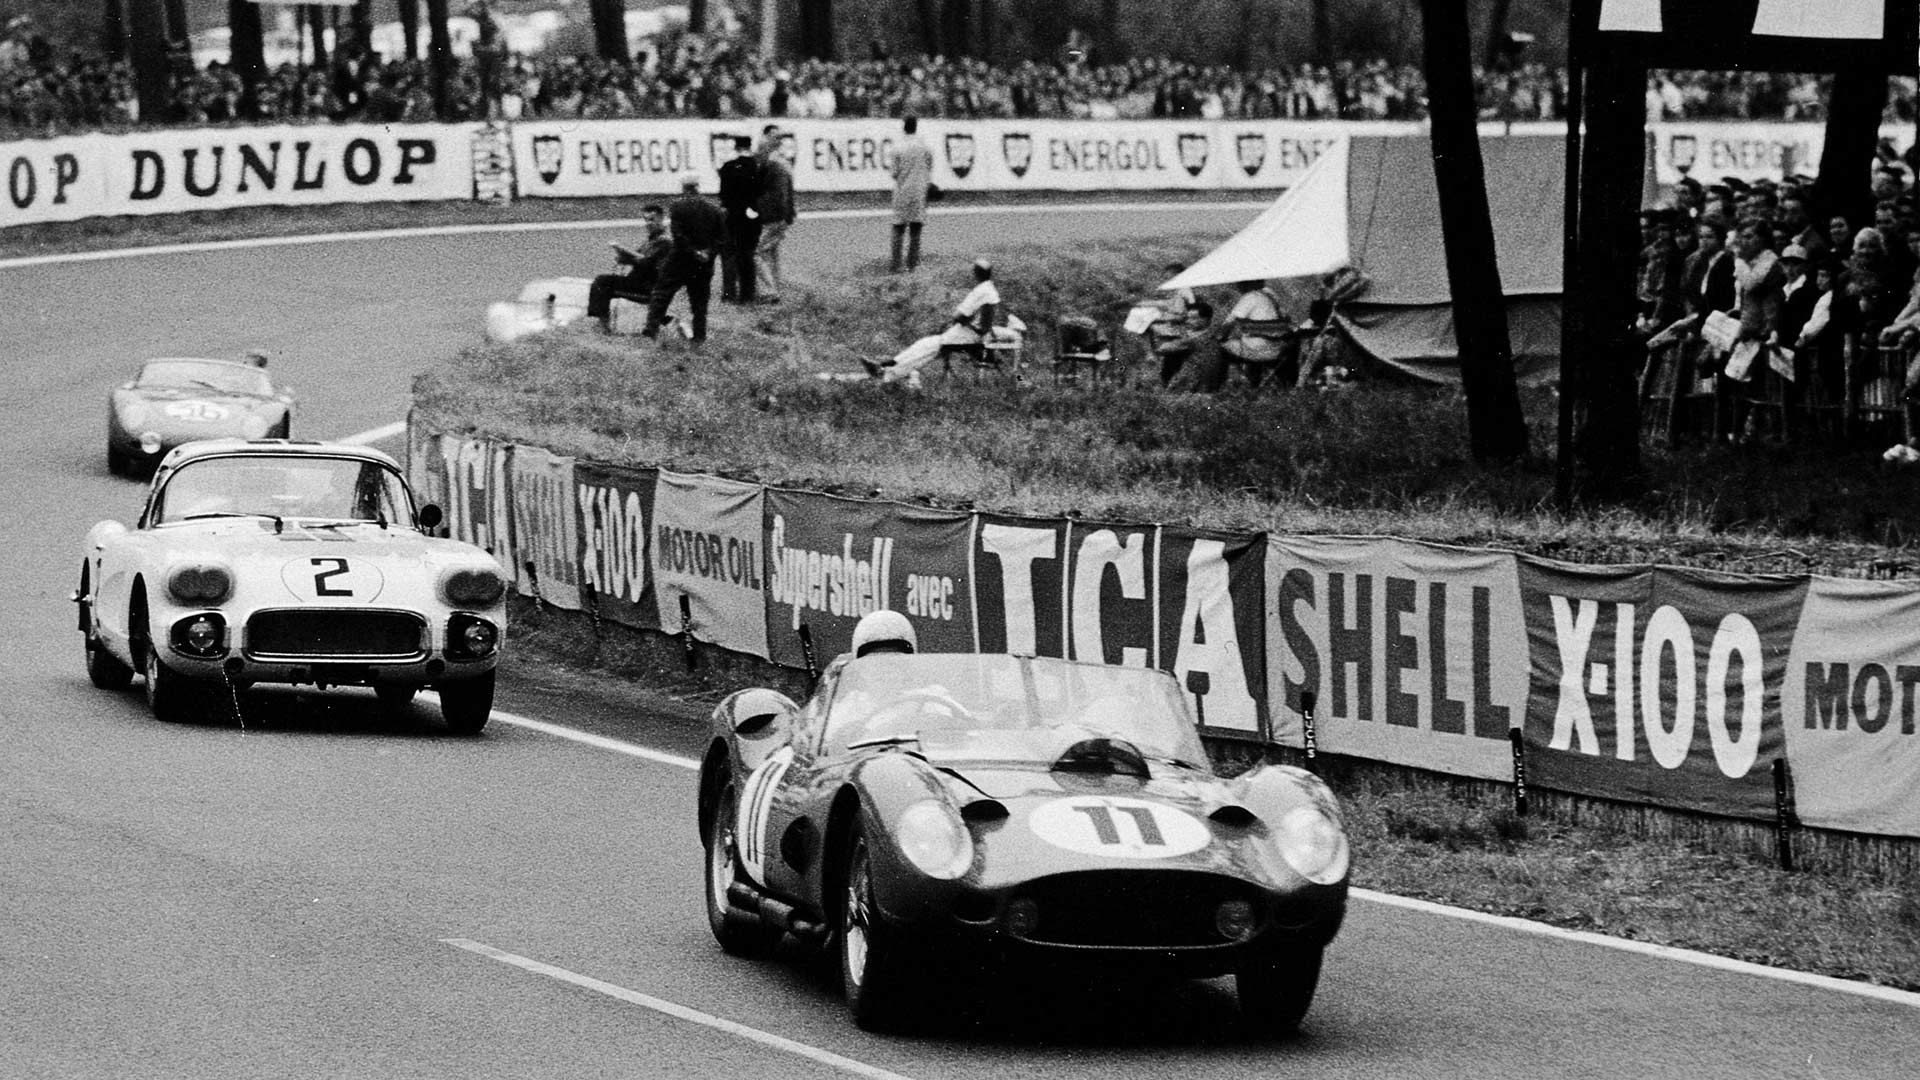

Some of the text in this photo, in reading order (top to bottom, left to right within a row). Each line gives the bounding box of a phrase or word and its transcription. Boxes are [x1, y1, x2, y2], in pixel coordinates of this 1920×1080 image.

[9, 153, 79, 209] OP
[130, 137, 436, 200] DUNLOP
[580, 138, 696, 174] ENERGOL
[1049, 138, 1167, 171] ENERGOL
[579, 483, 645, 603] X-100
[657, 524, 761, 591] MOTOR OIL
[771, 514, 954, 630] Supershell avec
[310, 558, 354, 597] 2
[981, 523, 1259, 732] TCA
[1278, 567, 1510, 742] SHELL
[1547, 594, 1764, 779] X-100
[1803, 660, 1920, 735] MOT
[1304, 710, 1316, 759] LUCAS
[1514, 747, 1526, 798] LUCAS
[1072, 806, 1166, 846] 11
